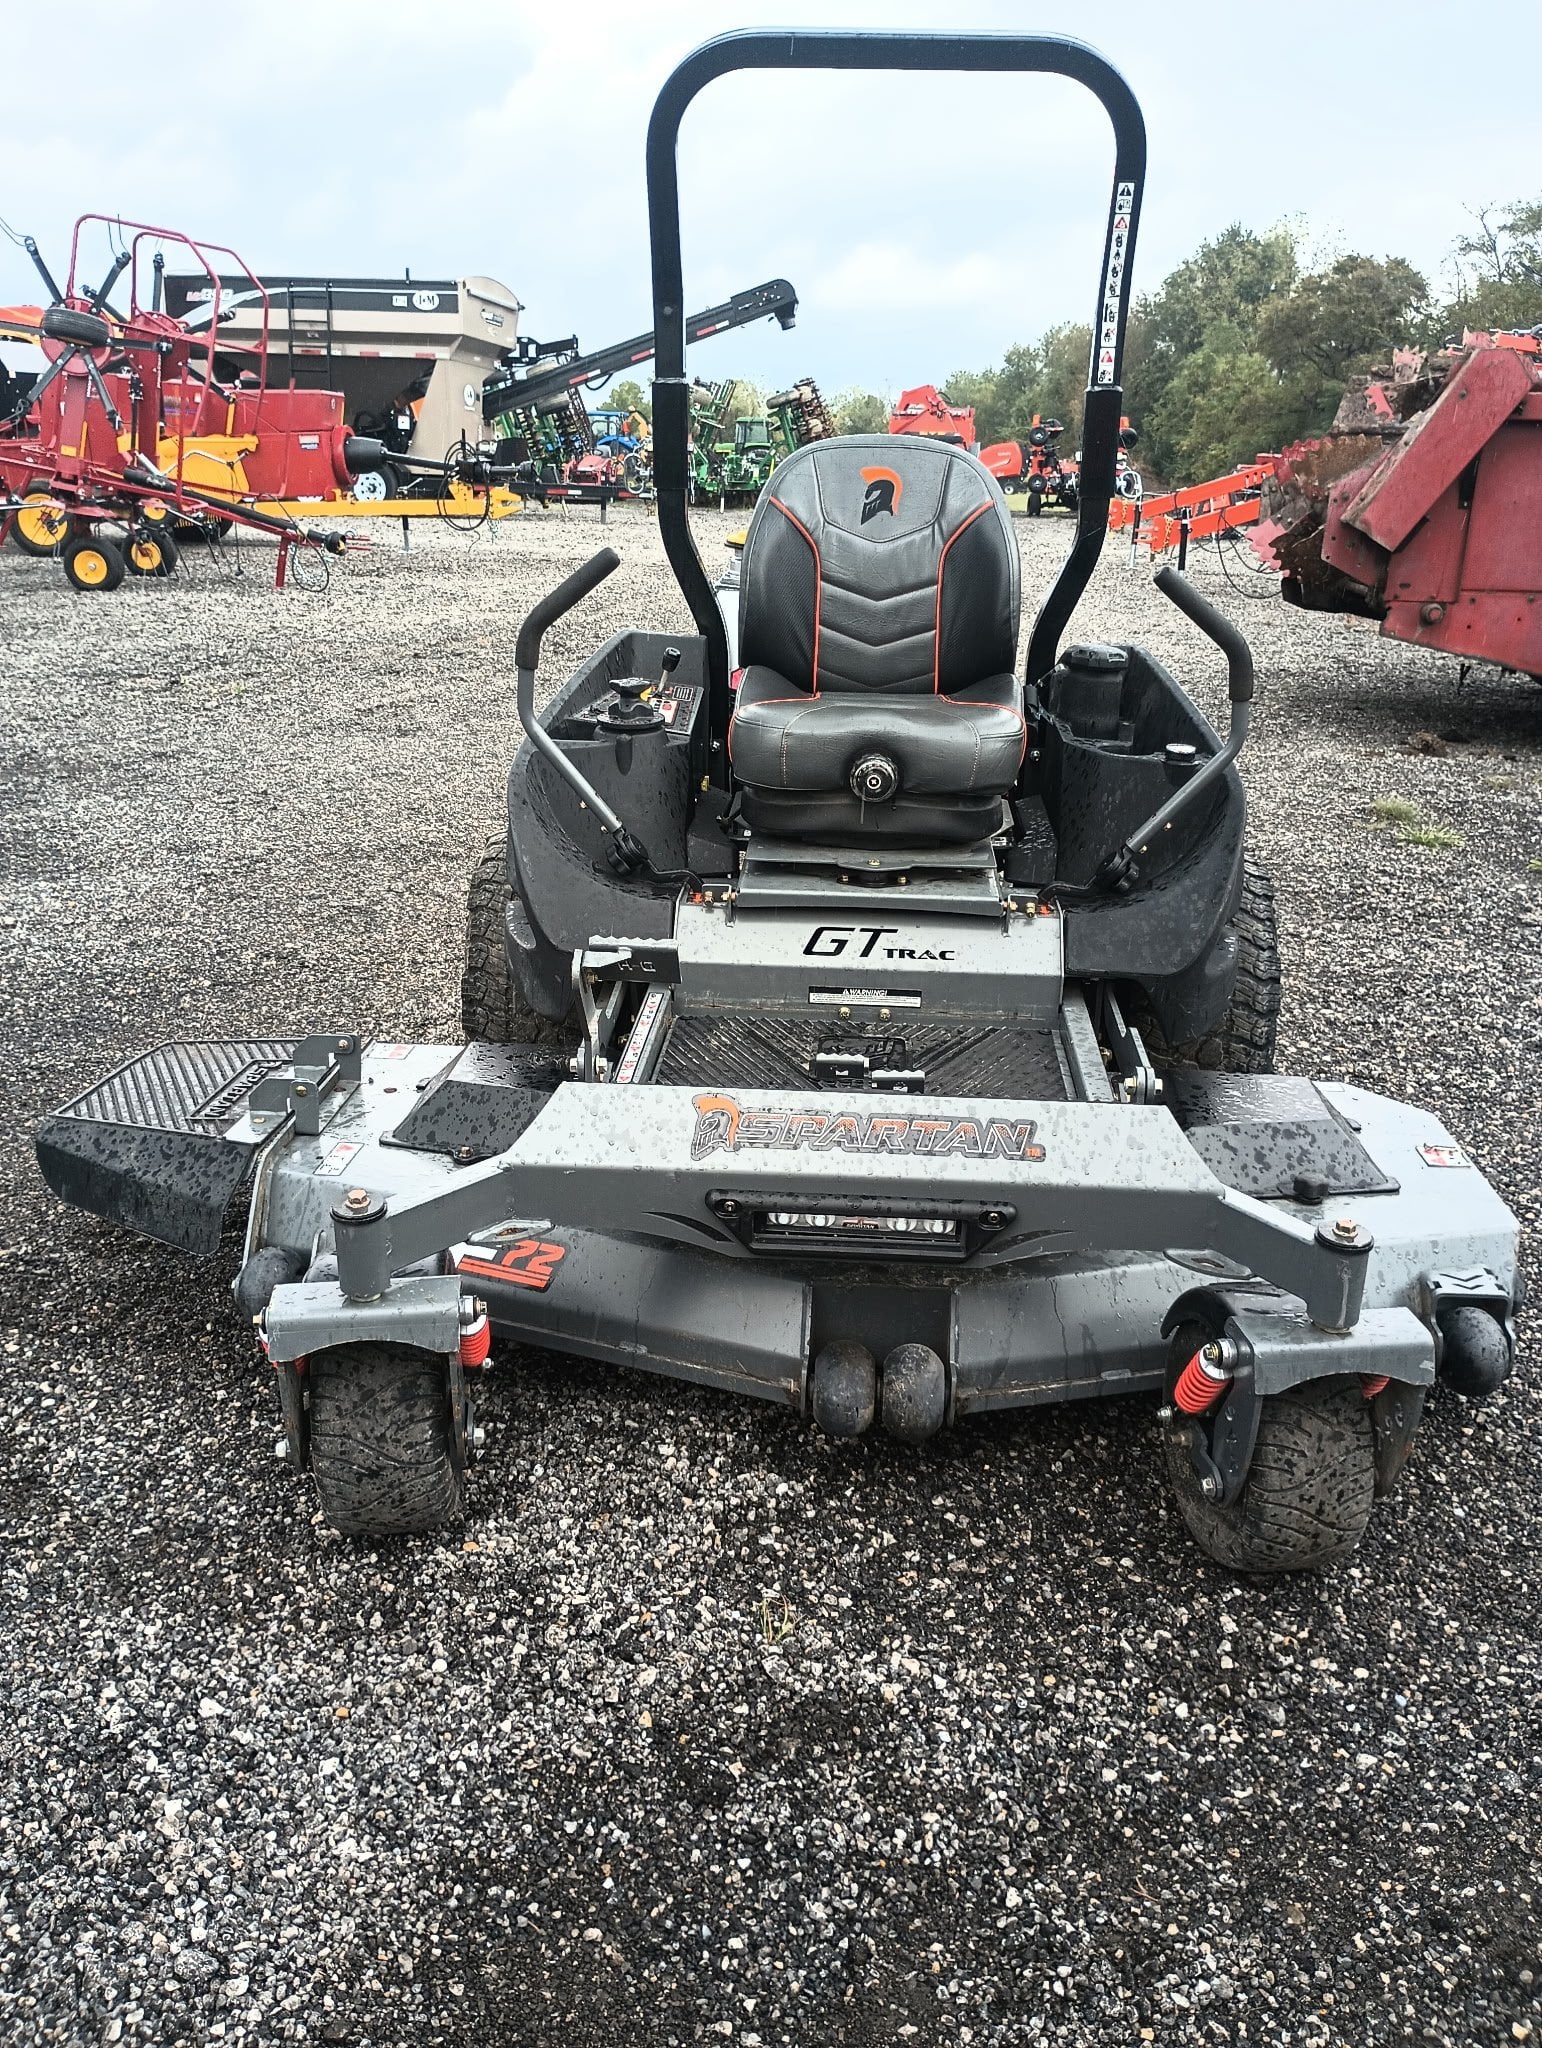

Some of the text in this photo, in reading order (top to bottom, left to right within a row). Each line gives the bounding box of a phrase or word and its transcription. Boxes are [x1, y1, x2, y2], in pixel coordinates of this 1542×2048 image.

[802, 926, 955, 961] GT TRAC
[848, 988, 888, 997] WARNING!
[735, 1112, 1033, 1157] SPARTAN
[501, 1239, 566, 1275] 72
